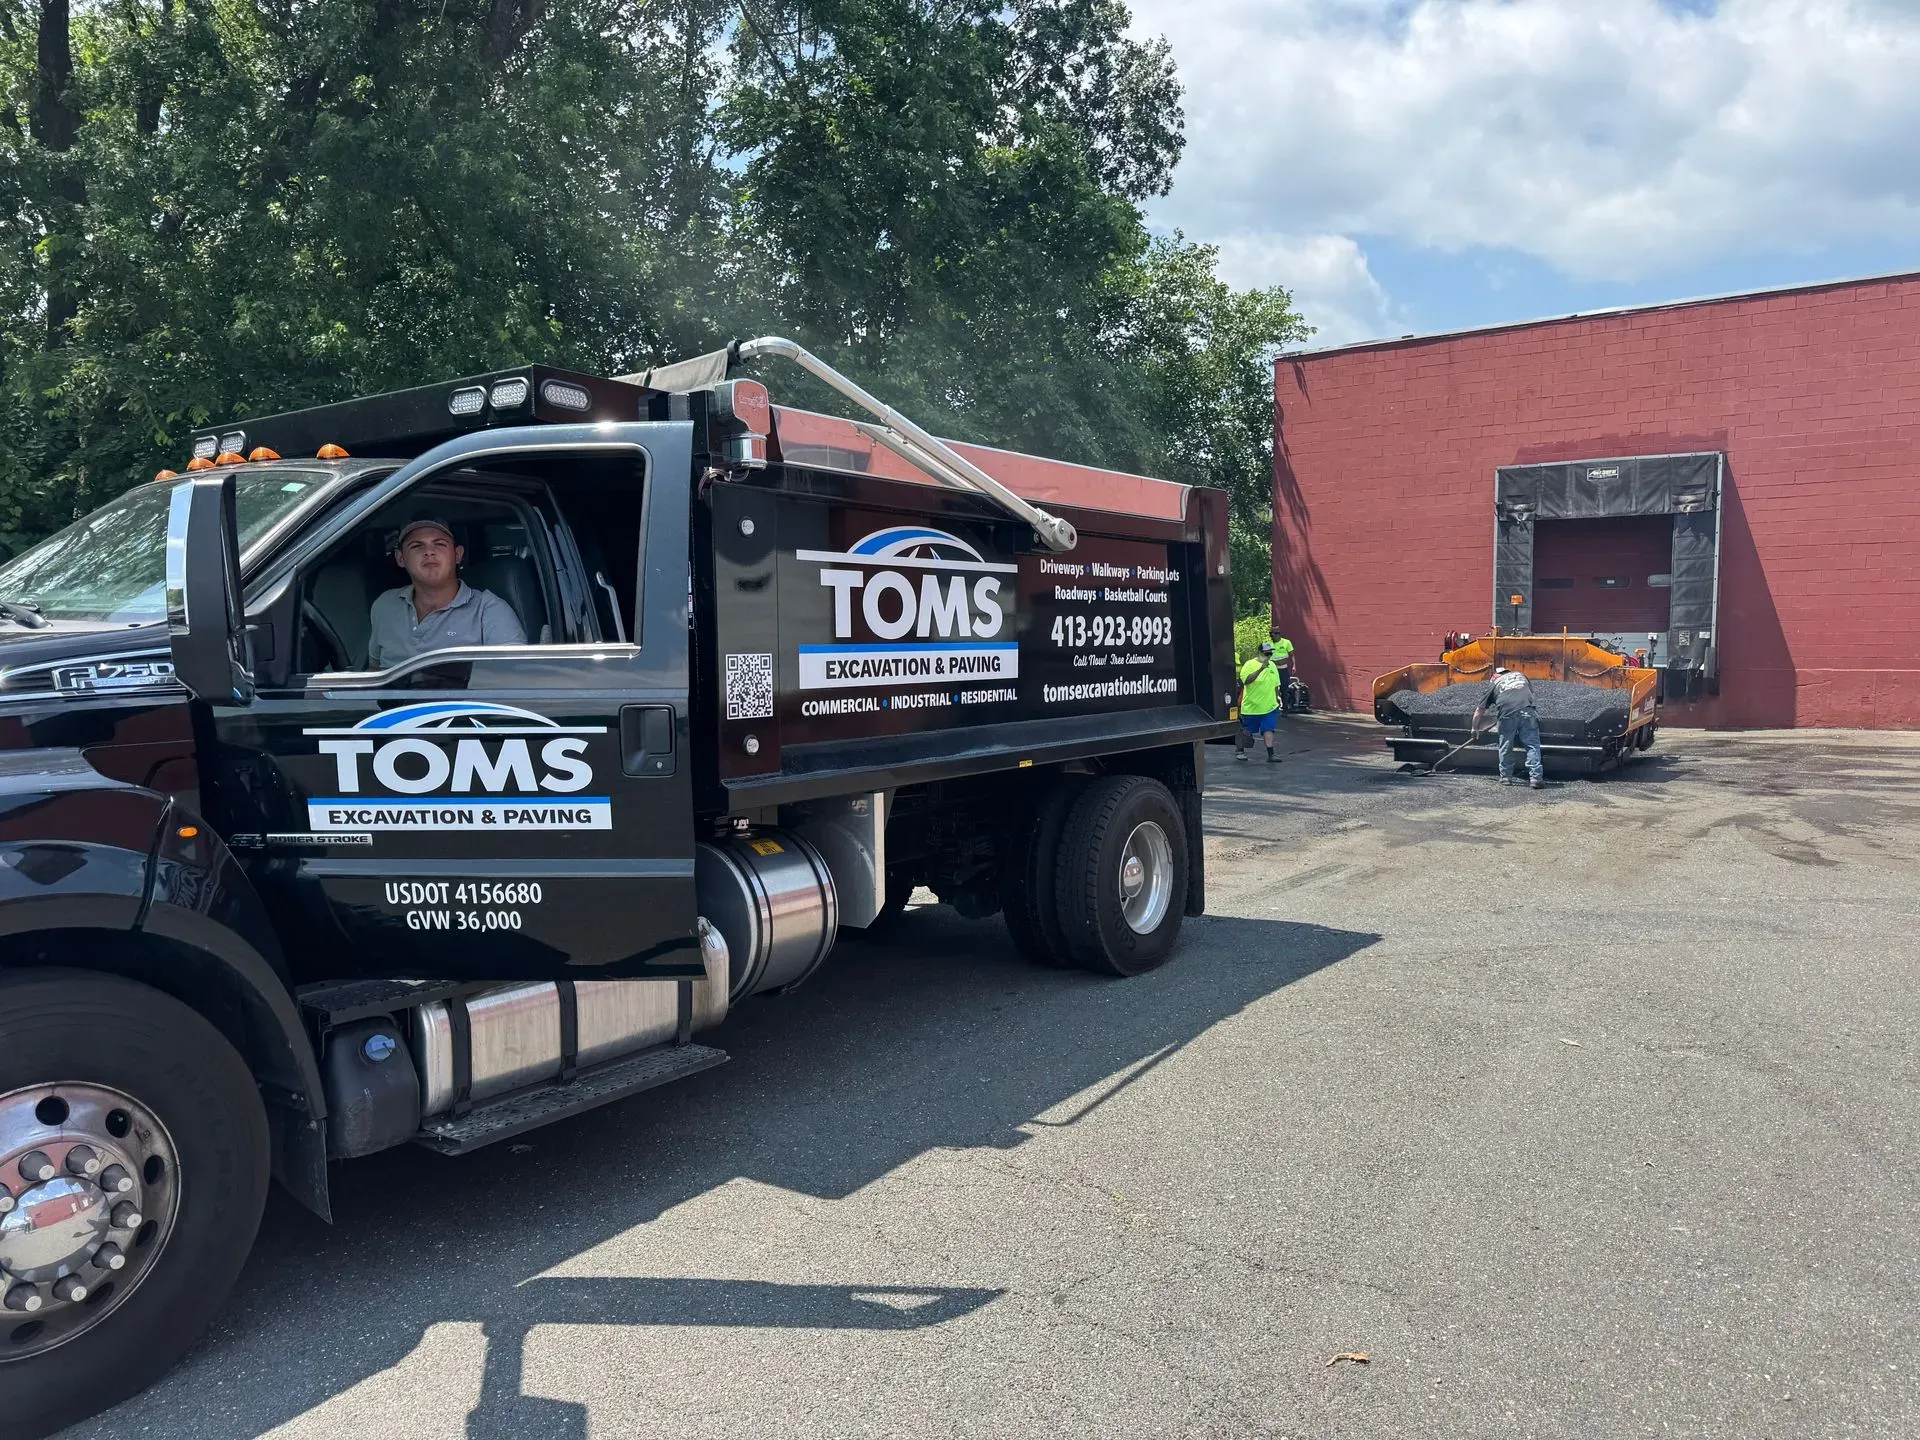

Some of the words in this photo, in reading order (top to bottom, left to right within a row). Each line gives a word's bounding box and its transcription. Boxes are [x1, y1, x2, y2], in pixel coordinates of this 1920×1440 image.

[1040, 559, 1084, 578] Driveways
[1092, 563, 1130, 581] Walkways
[1137, 566, 1164, 583] Parking
[1165, 568, 1180, 581] Lots
[820, 568, 1003, 640] TOMS
[1055, 586, 1096, 603] Roadways
[1104, 587, 1143, 602] Basketball
[1145, 589, 1168, 603] Courts
[1051, 615, 1172, 647] 413-923-8993
[825, 657, 930, 680] EXCAVATION
[934, 655, 945, 675] &
[949, 655, 1001, 674] PAVING
[1073, 654, 1088, 667] Call
[1088, 654, 1108, 667] Now!
[1110, 654, 1125, 665] Free
[1125, 653, 1154, 665] Estimates
[1043, 674, 1177, 703] tomsexcavationsllc.com
[801, 697, 880, 716] COMMERCIAL
[891, 692, 951, 710] INDUSTRIAL
[961, 688, 1018, 705] RESIDENTIAL
[318, 737, 593, 794] TOMS
[328, 809, 474, 825] EXCAVATION
[480, 809, 497, 824] &
[503, 808, 592, 824] PAVING
[317, 835, 369, 844] STROKE
[385, 882, 449, 905] USDOT
[455, 882, 542, 904] 4156680
[406, 910, 450, 930] GVW
[455, 910, 522, 933] 36,000
